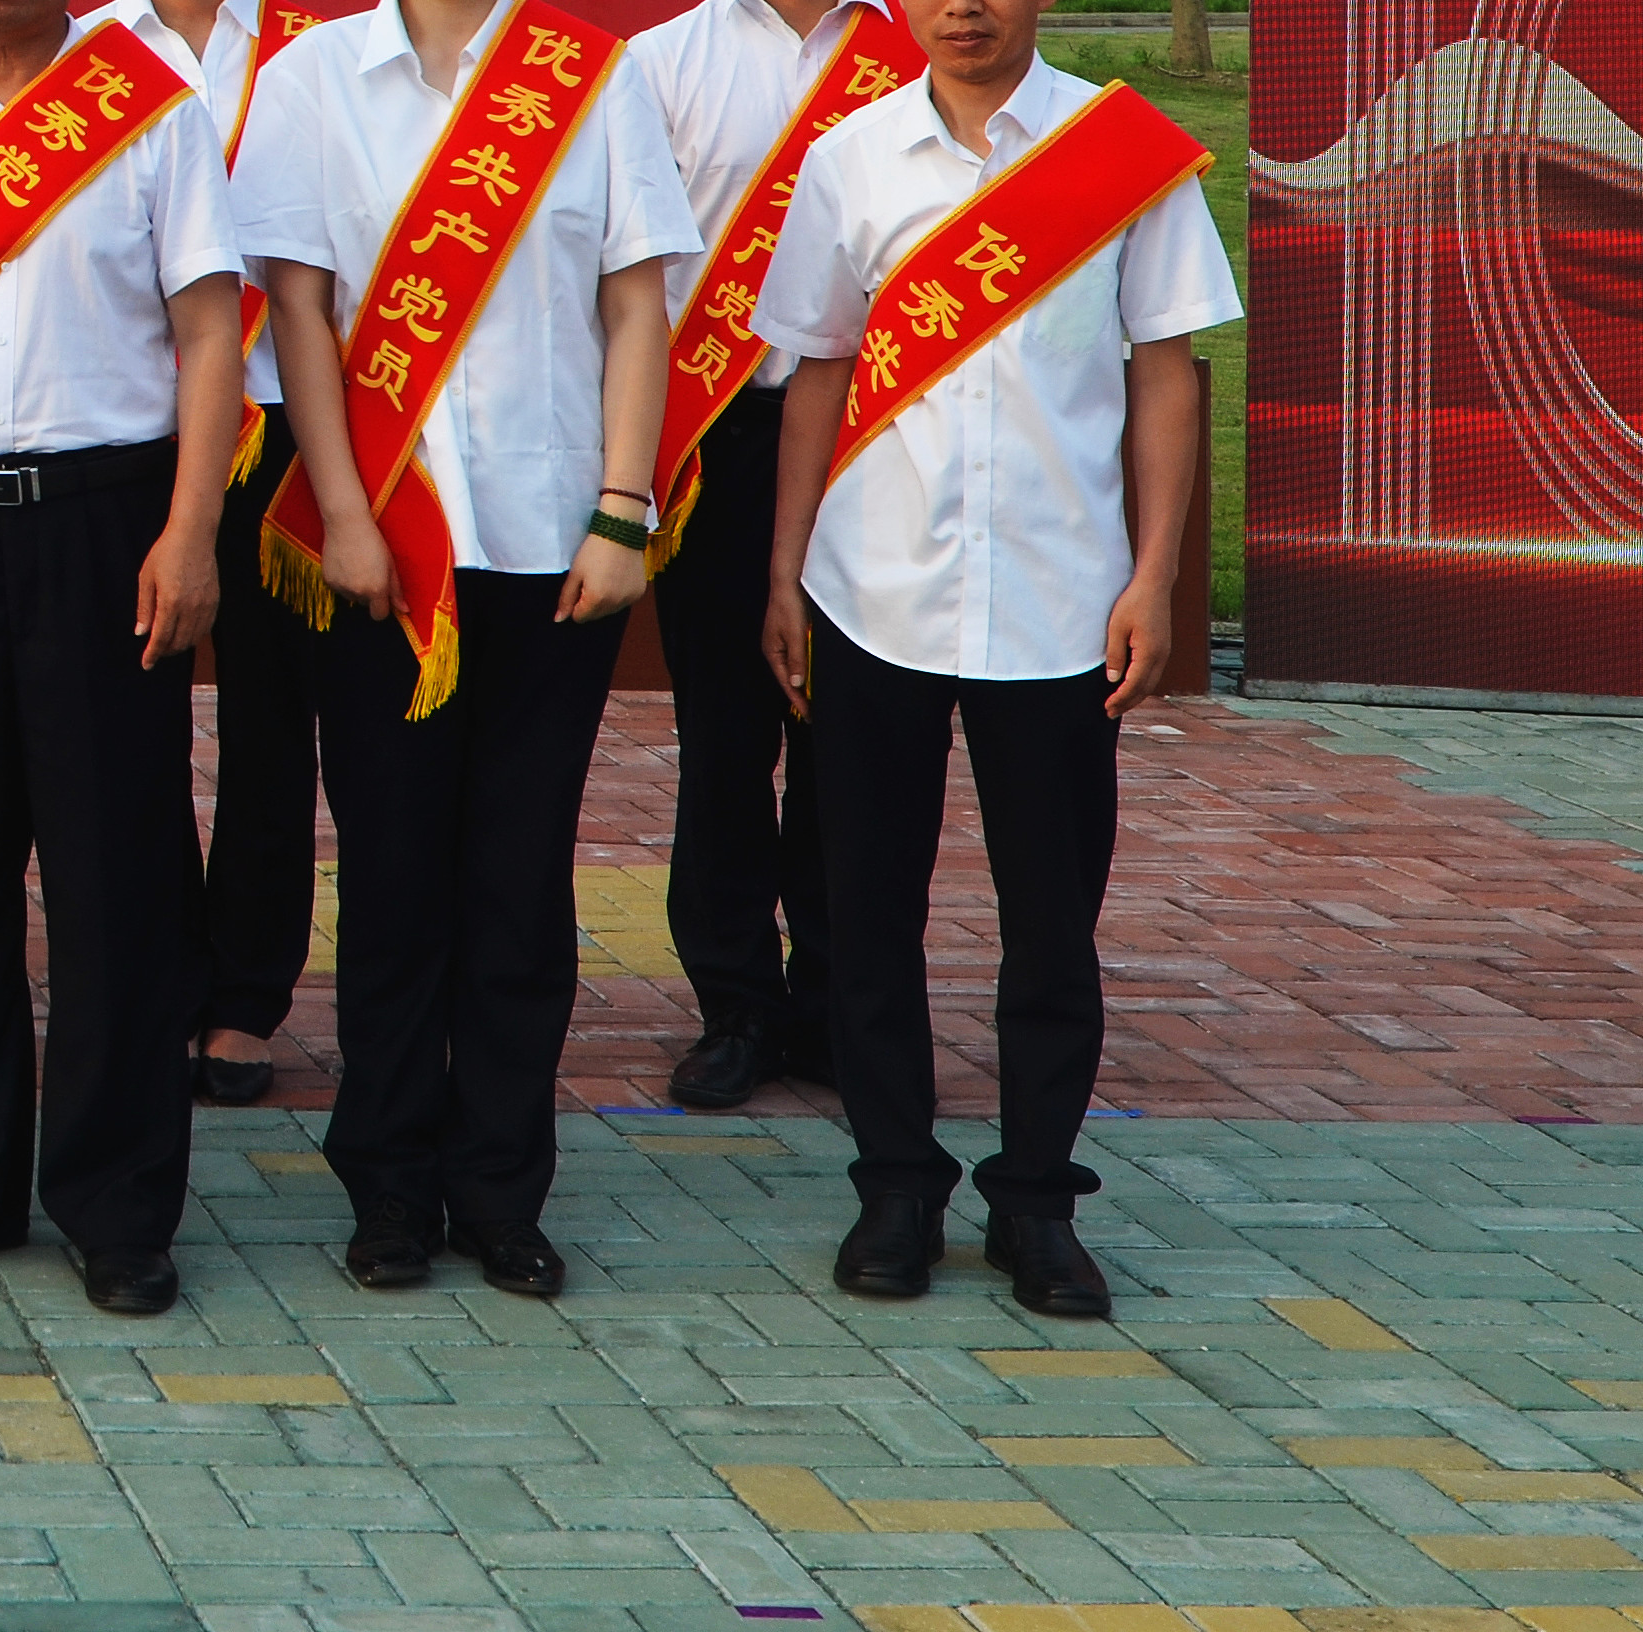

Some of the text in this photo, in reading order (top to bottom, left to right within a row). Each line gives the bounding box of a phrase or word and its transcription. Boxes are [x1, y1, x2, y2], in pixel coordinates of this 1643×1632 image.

[357, 24, 584, 412] 优秀共产党员
